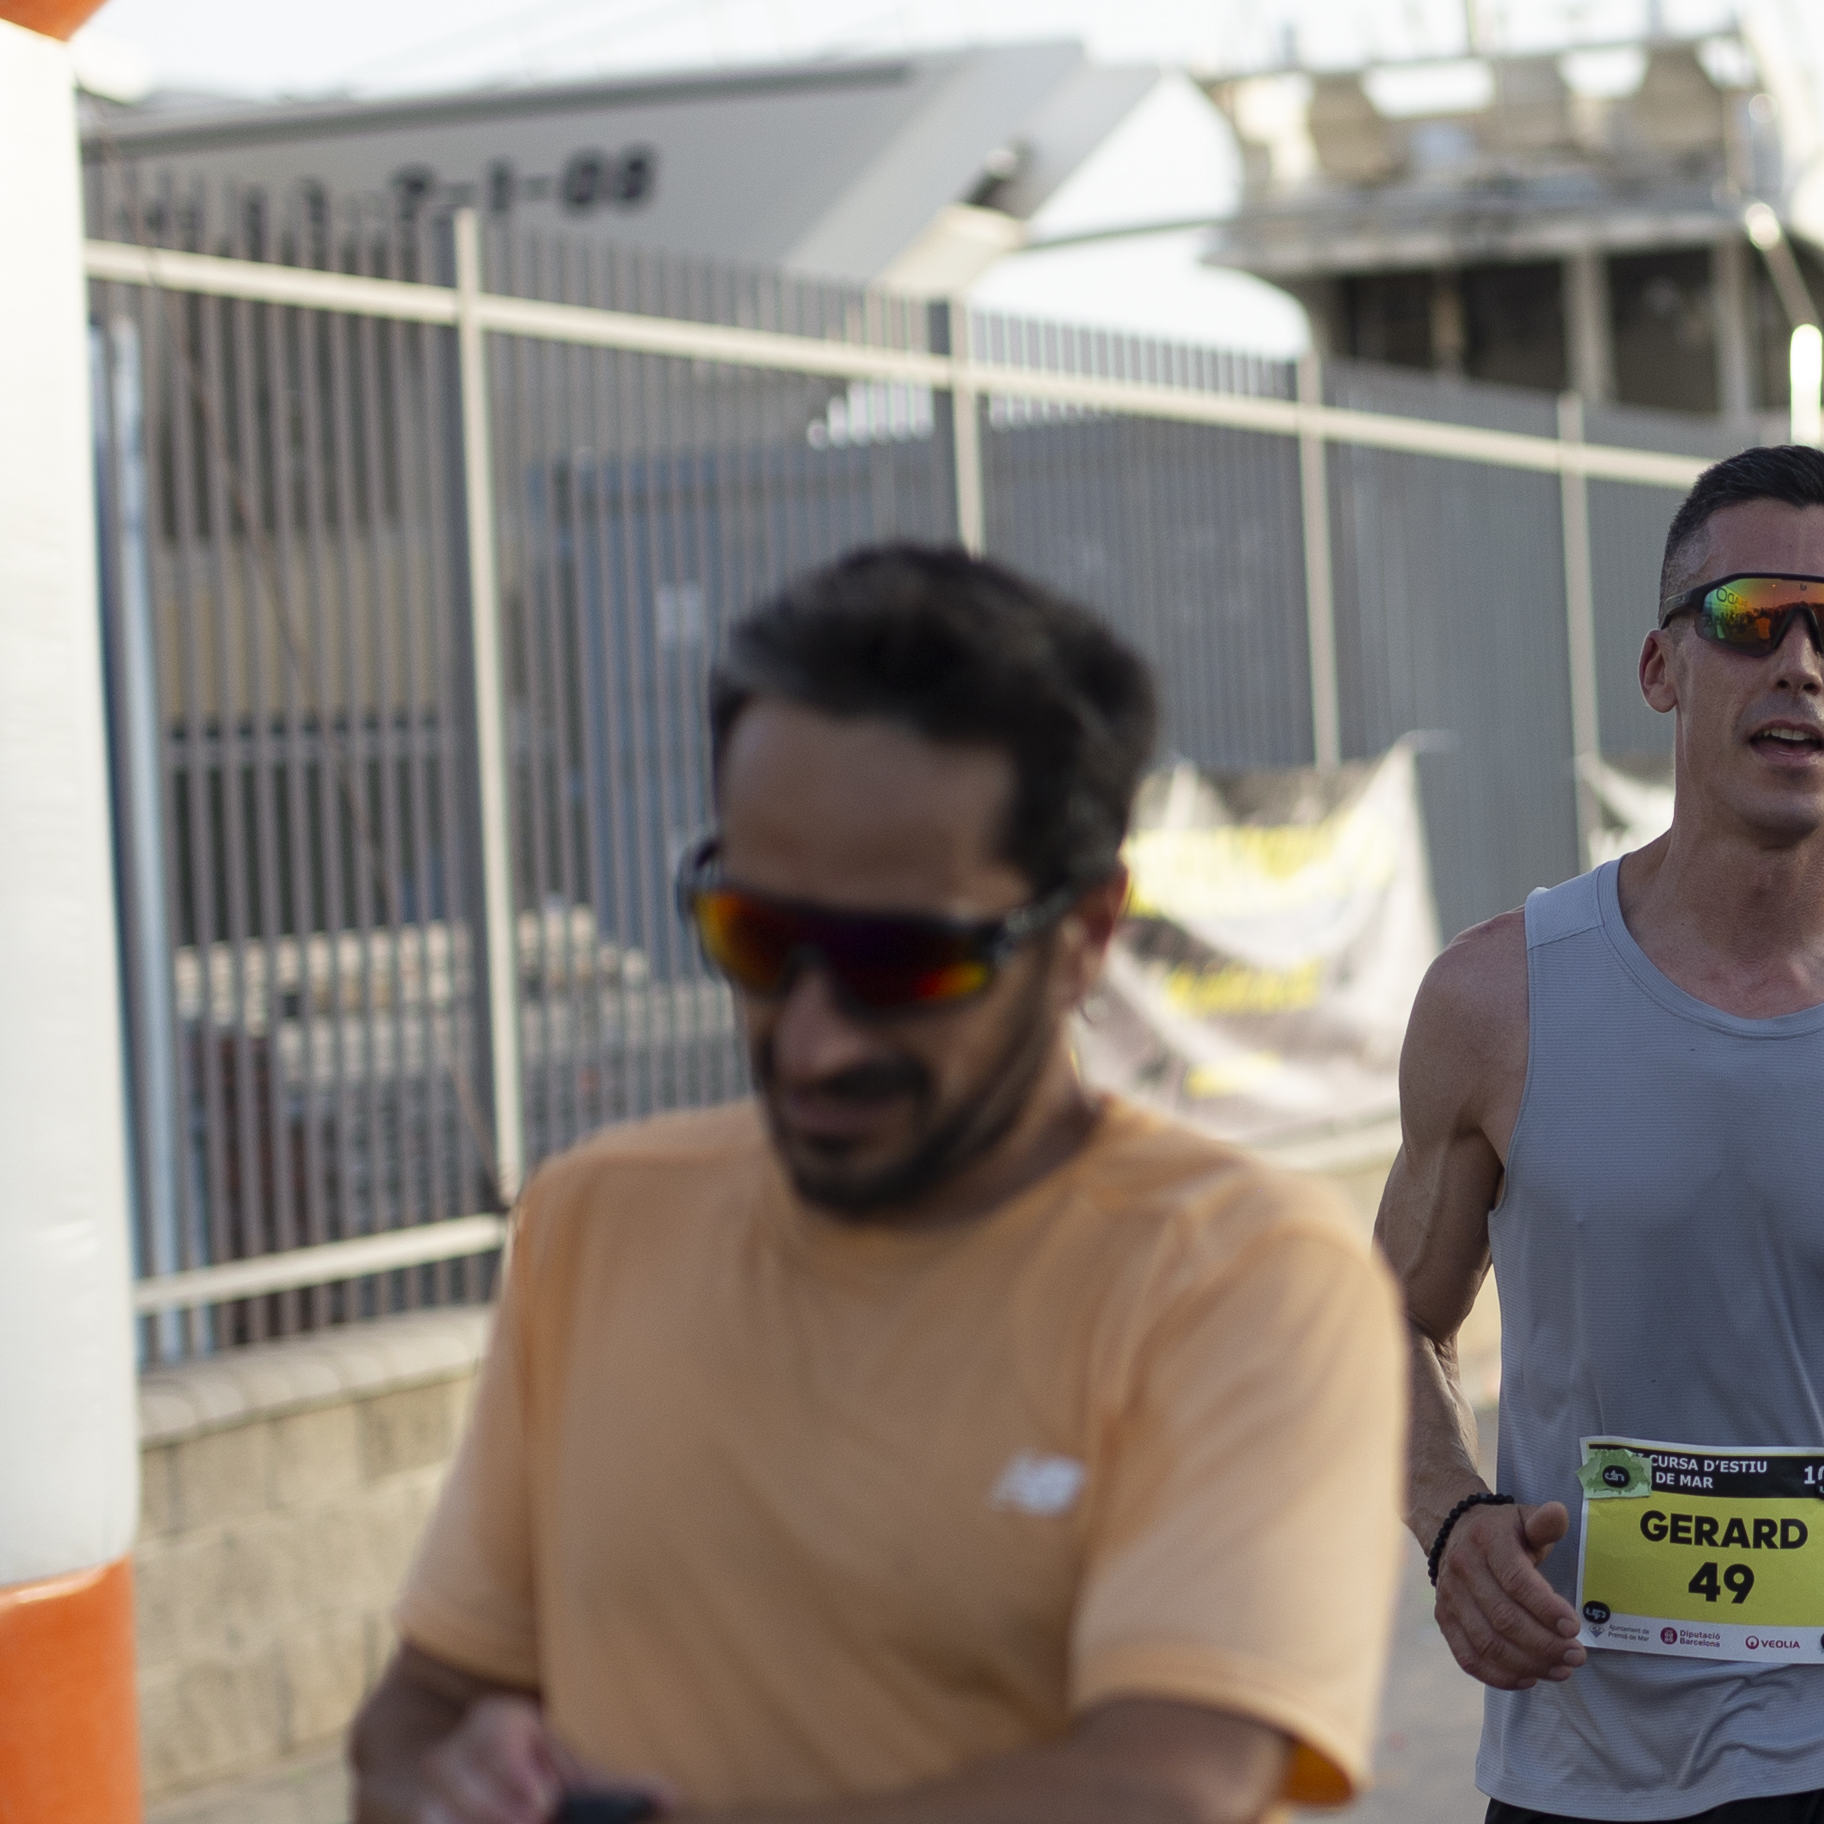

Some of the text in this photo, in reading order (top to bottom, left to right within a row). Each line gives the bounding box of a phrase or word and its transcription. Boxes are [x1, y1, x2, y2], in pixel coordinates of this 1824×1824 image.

[1651, 1455, 1767, 1474] CURSA D'ESTIU
[1656, 1472, 1713, 1489] DE MAR
[1640, 1510, 1808, 1550] GERARD
[1688, 1561, 1755, 1604] 49
[1761, 1639, 1800, 1649] VEOLIA
